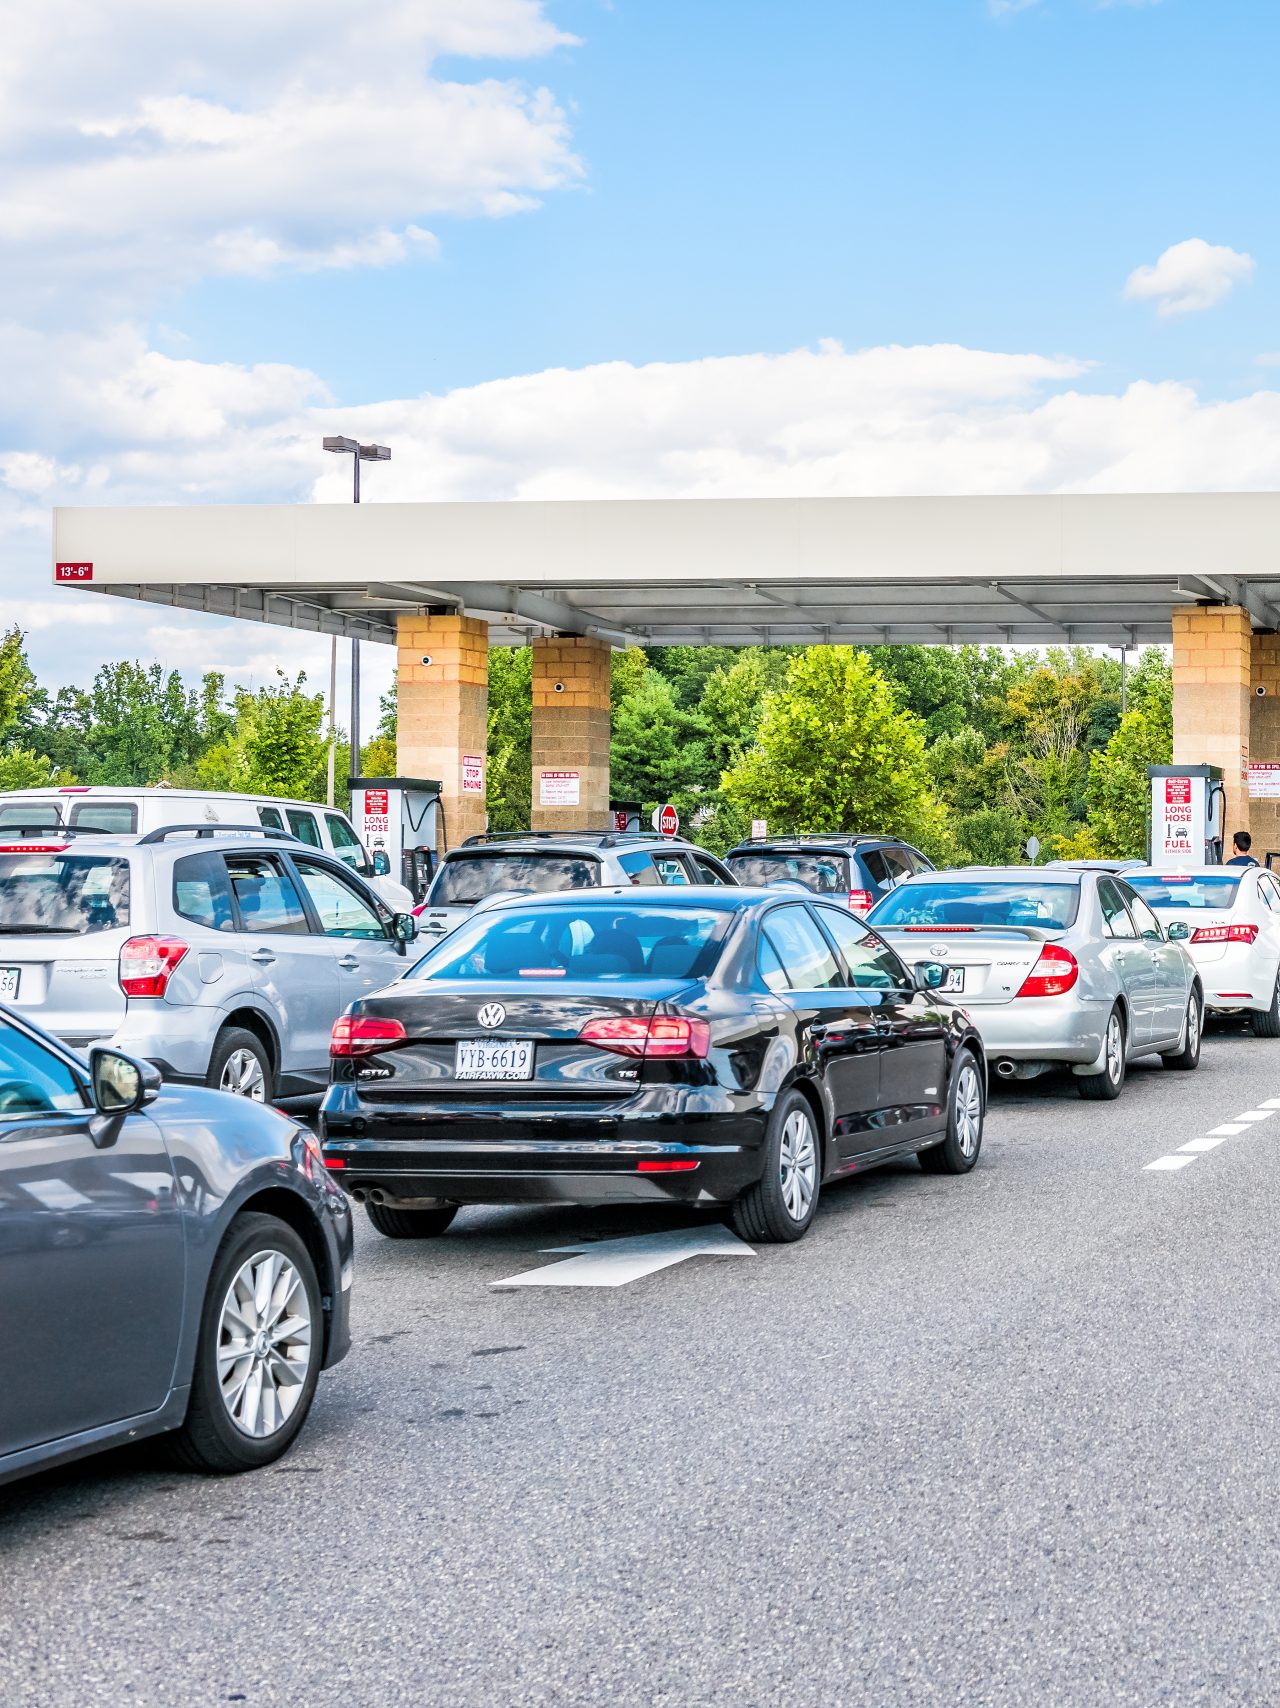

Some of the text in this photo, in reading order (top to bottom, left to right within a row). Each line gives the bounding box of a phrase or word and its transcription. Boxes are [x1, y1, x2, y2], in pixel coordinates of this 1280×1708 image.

[61, 566, 88, 576] 13'-6"
[466, 769, 479, 778] STOP
[464, 780, 481, 789] ENGINE
[662, 816, 676, 829] STOP
[460, 1050, 526, 1067] VYB-6619
[455, 1071, 528, 1079] FAIRFAXVW.COM
